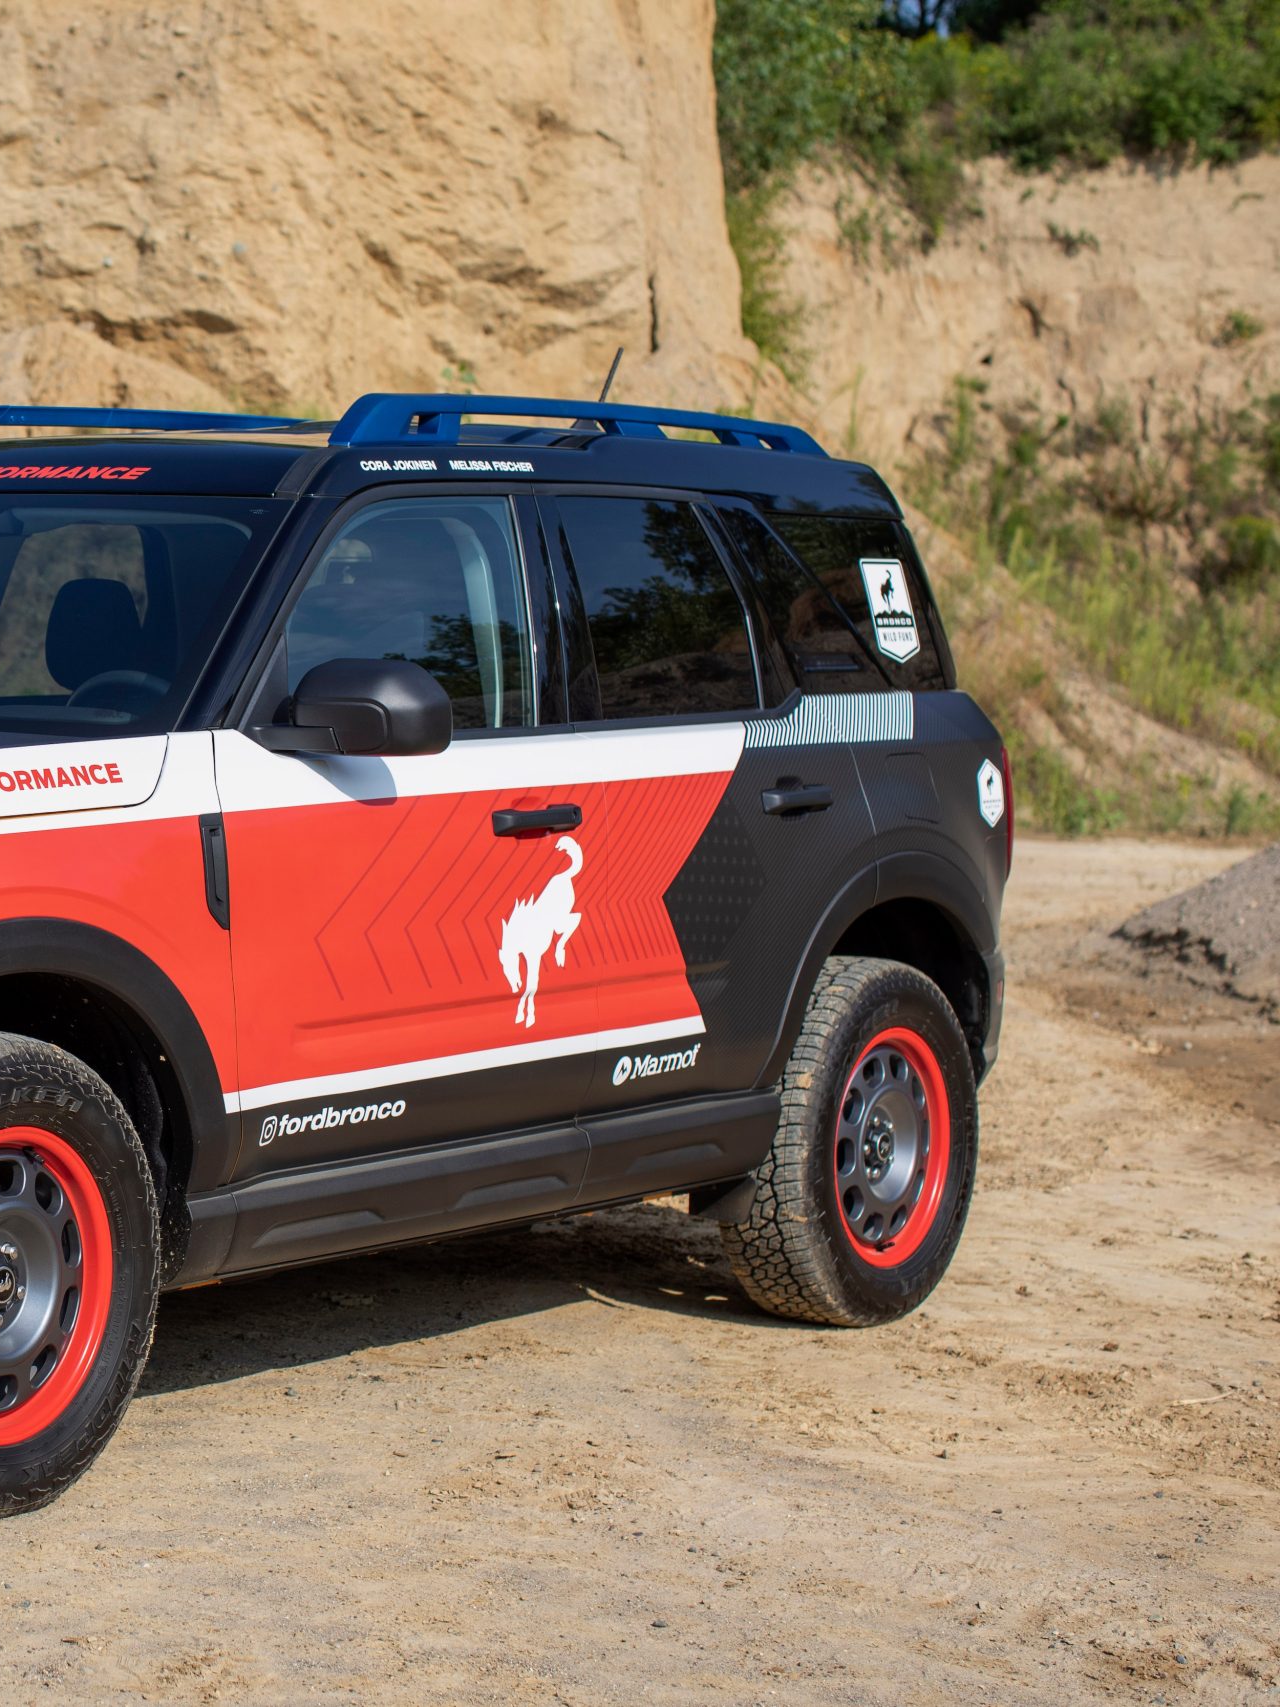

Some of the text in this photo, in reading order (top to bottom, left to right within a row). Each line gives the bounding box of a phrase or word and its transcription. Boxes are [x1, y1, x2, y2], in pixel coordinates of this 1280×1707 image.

[359, 460, 534, 473] CORA JOKINEN MELISSA FISCHER
[877, 618, 912, 626] BRONCO
[629, 1043, 701, 1080] Marmot
[277, 1099, 406, 1137] fordbronco
